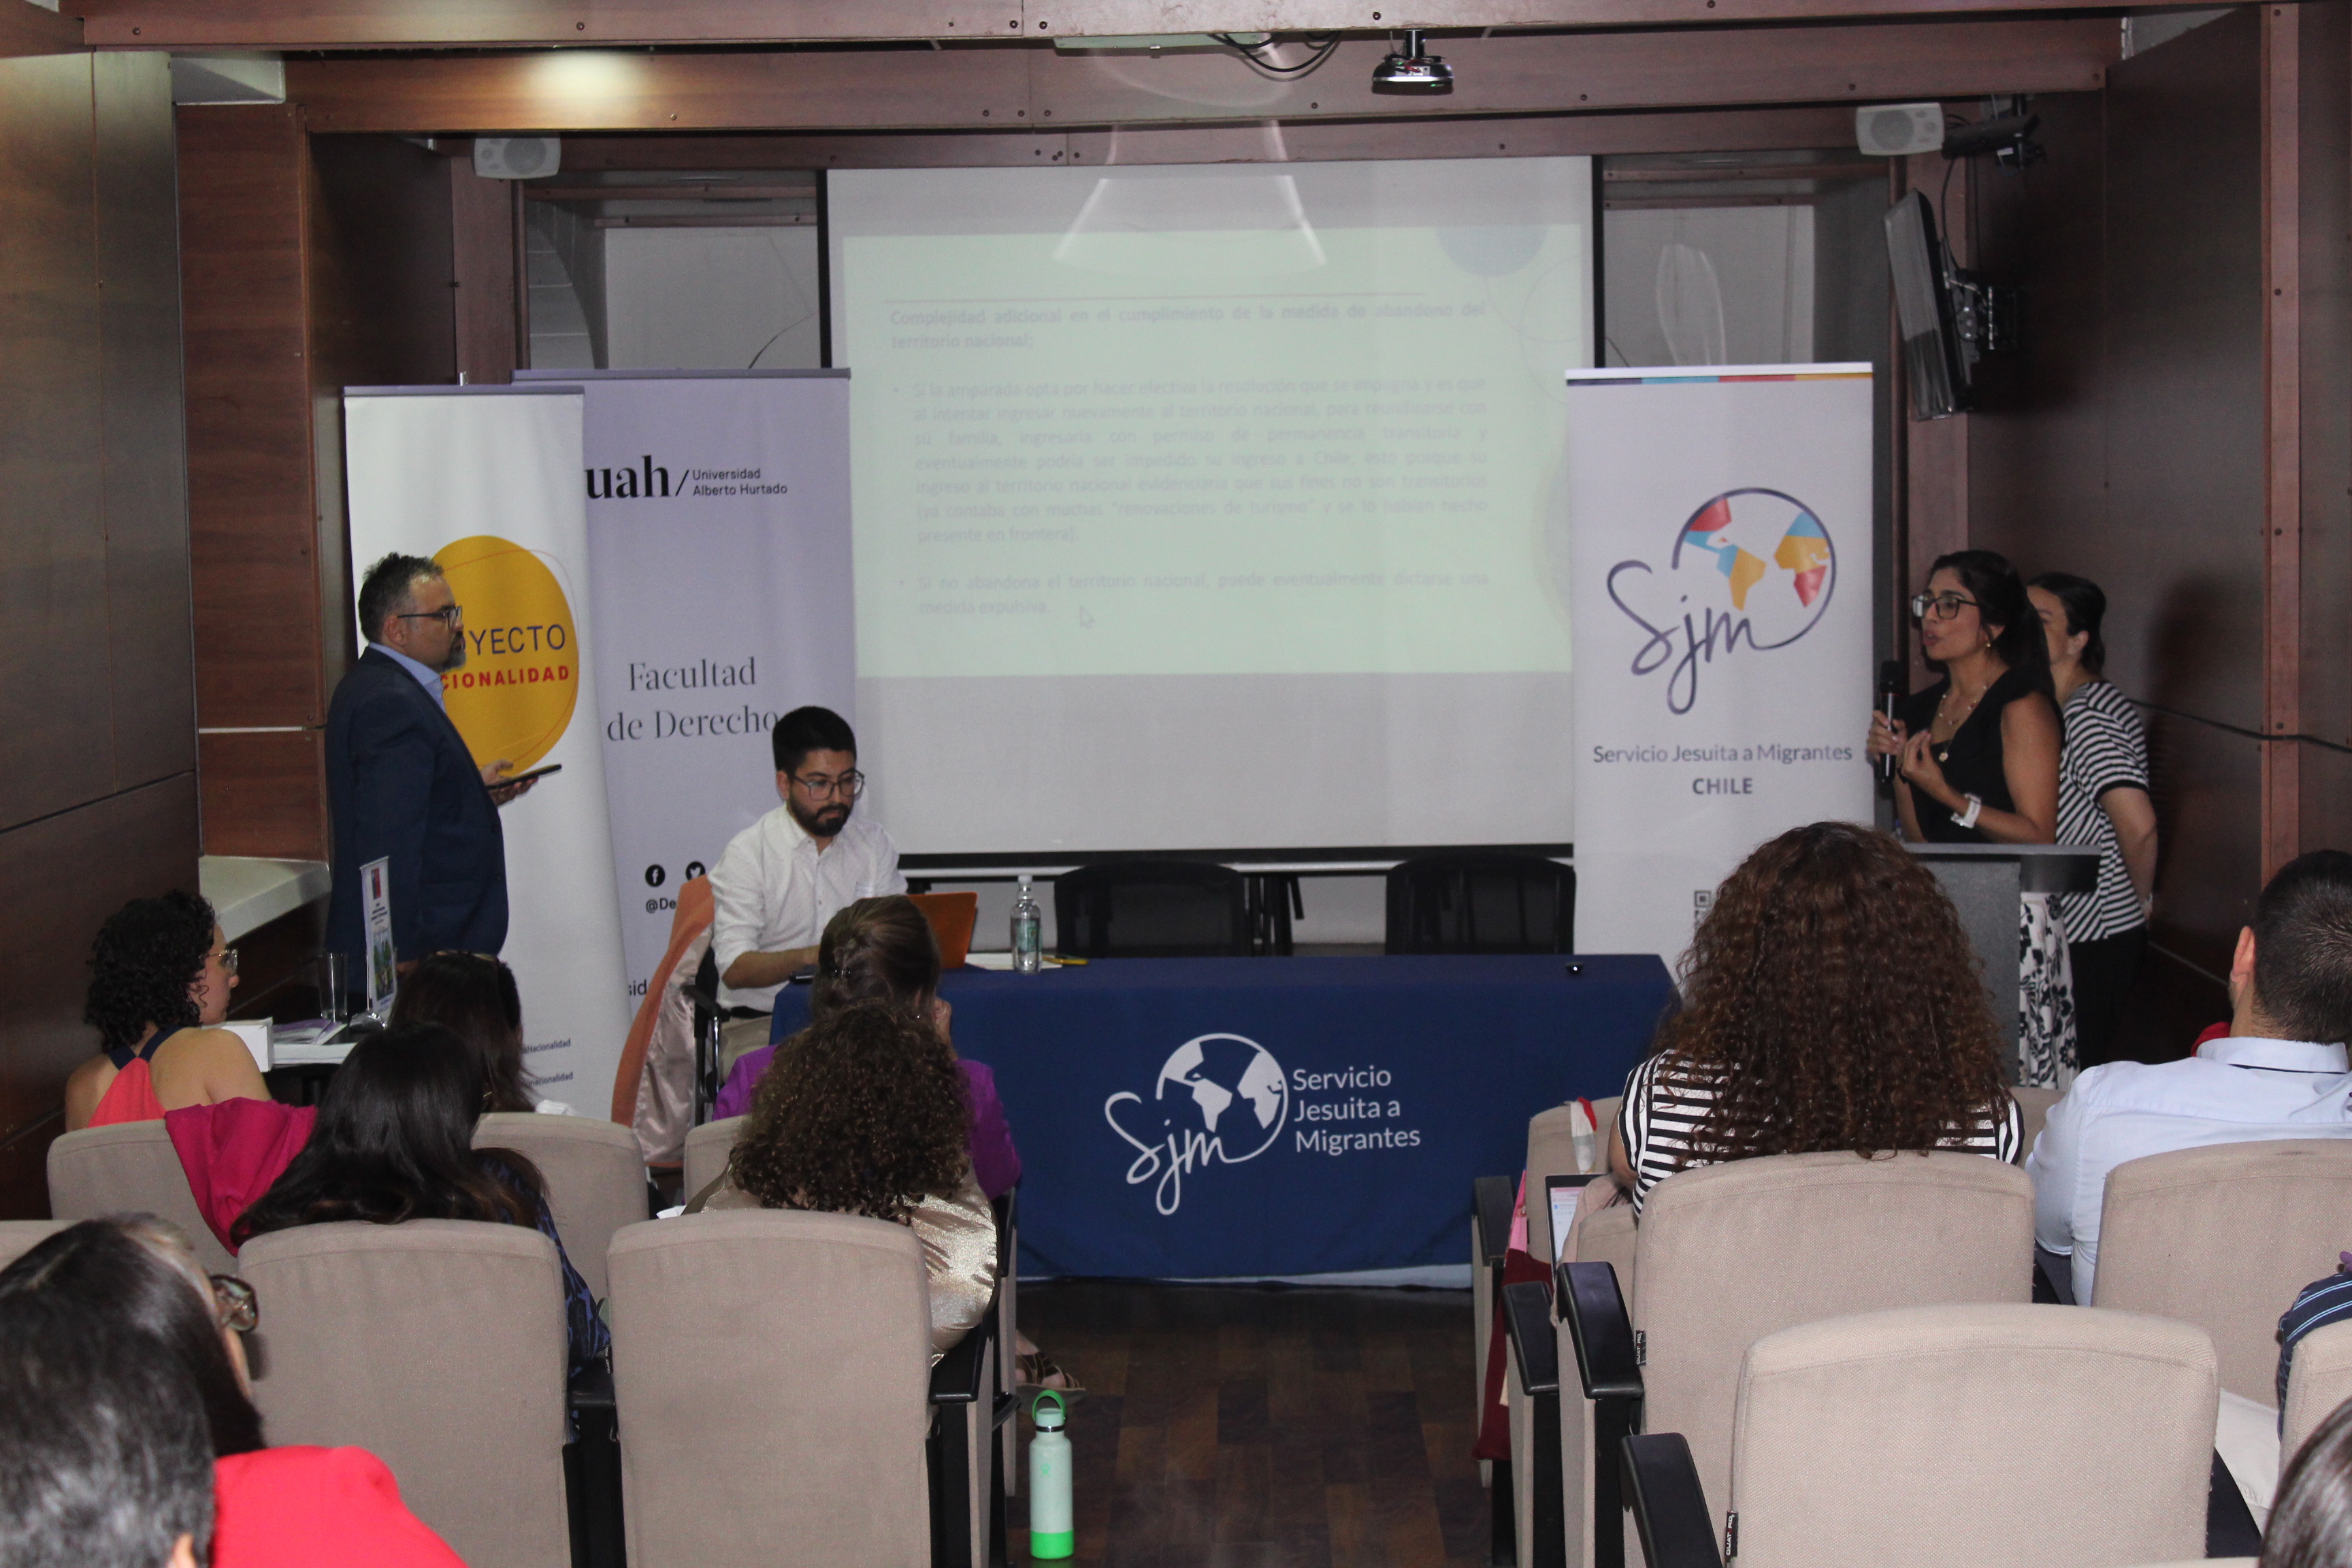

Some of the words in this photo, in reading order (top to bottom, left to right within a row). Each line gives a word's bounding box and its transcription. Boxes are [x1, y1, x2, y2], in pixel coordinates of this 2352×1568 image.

[889, 308, 985, 329] Complejidad
[994, 306, 1062, 323] adicional
[1069, 311, 1088, 322] en
[1096, 306, 1111, 322] el
[1118, 304, 1224, 326] cumplimiento
[1232, 304, 1251, 320] de
[1259, 304, 1273, 320] la
[1281, 302, 1339, 319] medida
[1347, 302, 1367, 318] de
[1375, 301, 1452, 318] abandono
[1460, 301, 1485, 316] del
[891, 331, 960, 348] territorio
[912, 381, 925, 397] Si
[929, 381, 942, 397] la
[947, 380, 1020, 402] amparada
[1026, 381, 1058, 400] opta
[1064, 383, 1088, 399] por
[1093, 378, 1133, 394] hacer
[1139, 376, 1196, 393] efectiva
[1202, 376, 1214, 393] la
[1300, 379, 1327, 395] que
[1333, 378, 1348, 390] se
[1425, 377, 1433, 393] y
[1437, 377, 1451, 389] es
[1458, 376, 1486, 393] que
[914, 406, 926, 422] al
[932, 404, 990, 421] intentar
[998, 404, 1056, 425] ingresar
[1063, 404, 1154, 419] nuevamente
[1161, 402, 1173, 418] al
[1179, 401, 1247, 418] territorio
[1326, 404, 1358, 421] para
[1459, 402, 1486, 414] con
[915, 434, 931, 445] su
[1110, 432, 1136, 443] con
[1154, 426, 1214, 448] permiso
[1232, 426, 1250, 442] de
[1267, 425, 1365, 446] permanencia
[1478, 428, 1487, 444] y
[915, 452, 1026, 469] eventualmente
[1094, 456, 1115, 468] ser
[1126, 451, 1195, 472] impedido
[1207, 455, 1222, 466] su
[1232, 450, 1286, 471] ingreso
[1295, 455, 1305, 466] a
[1406, 453, 1459, 470] porque
[1471, 453, 1488, 464] su
[691, 468, 761, 480] Universidad
[692, 485, 737, 496] Alberto
[739, 483, 788, 495] Hurtado
[915, 477, 970, 498] ingreso
[977, 477, 990, 493] al
[996, 476, 1062, 493] territorio
[1070, 476, 1131, 492] nacional
[1235, 479, 1262, 495] que
[1270, 479, 1292, 490] sus
[1300, 474, 1335, 490] fines
[1342, 478, 1361, 489] no
[1368, 478, 1395, 489] son
[946, 501, 1004, 517] contaba
[1012, 505, 1039, 517] con
[1046, 500, 1102, 517] muchas
[1224, 498, 1241, 514] de
[1322, 502, 1332, 519] y
[1338, 502, 1354, 514] se
[1441, 496, 1488, 512] hecho
[917, 527, 982, 546] presente
[986, 529, 1004, 541] en
[917, 573, 932, 589] Si
[939, 578, 958, 589] no
[967, 572, 1040, 589] abandona
[1047, 572, 1061, 589] el
[1067, 572, 1136, 589] territorio
[1218, 571, 1265, 592] puede
[1272, 570, 1386, 587] eventualmente
[1393, 570, 1452, 586] dictarse
[1460, 574, 1489, 586] una
[918, 597, 975, 614] medida
[461, 623, 566, 656] YECTO
[630, 655, 756, 691] Facultad
[606, 711, 643, 742] de
[655, 705, 781, 739] Derecho
[1592, 745, 1669, 764] Servicio
[1671, 744, 1739, 763] Jesuita
[1742, 748, 1753, 762] a
[1757, 743, 1853, 765] Migrantes
[1691, 777, 1754, 795] CHILE
[1292, 1064, 1392, 1091] Servicio
[1294, 1096, 1381, 1122] Jesuita
[1386, 1100, 1401, 1117] a
[1295, 1127, 1421, 1156] Migrantes
